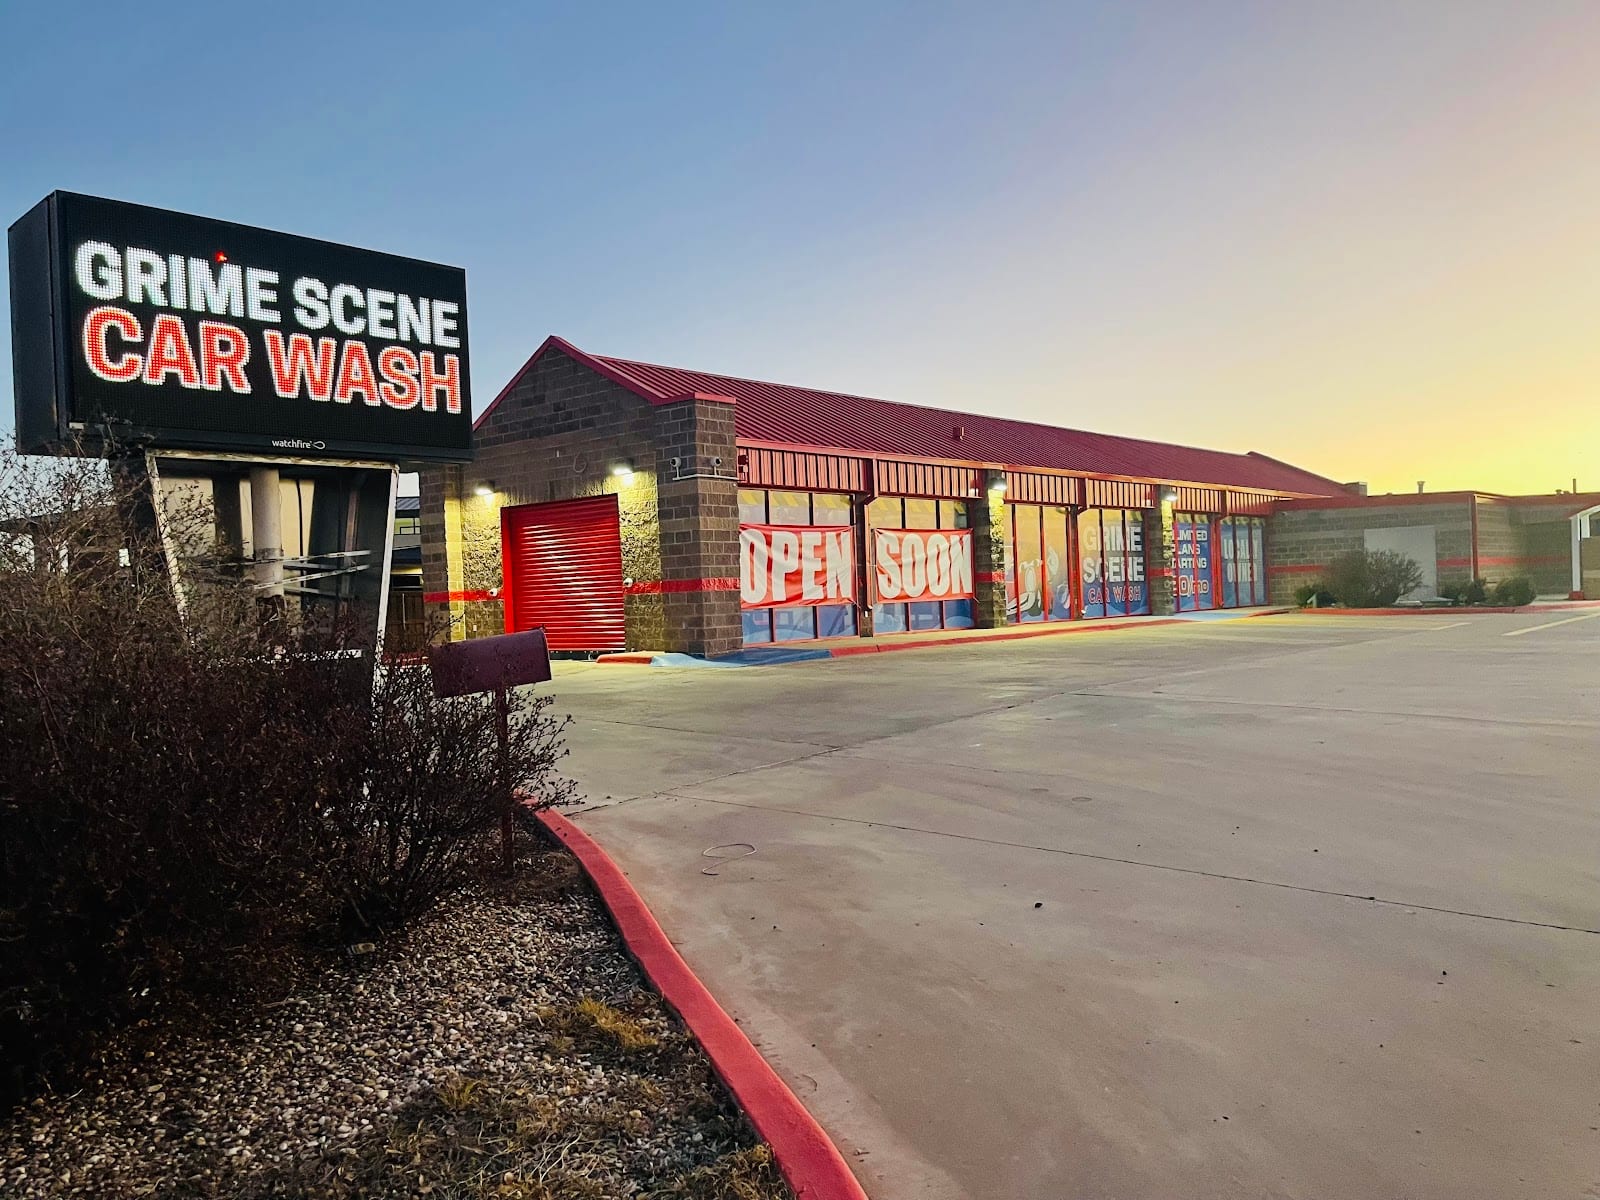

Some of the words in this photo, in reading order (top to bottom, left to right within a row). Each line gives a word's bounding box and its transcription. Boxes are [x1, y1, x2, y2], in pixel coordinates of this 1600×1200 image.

[75, 239, 281, 323] GRIME
[292, 276, 461, 348] SCENE
[82, 306, 252, 394] CAR
[263, 329, 462, 414] WASH
[271, 439, 311, 449] watchfire
[739, 528, 851, 603] OPEN
[876, 533, 973, 599] SOON
[1224, 539, 1258, 560] LOCALY
